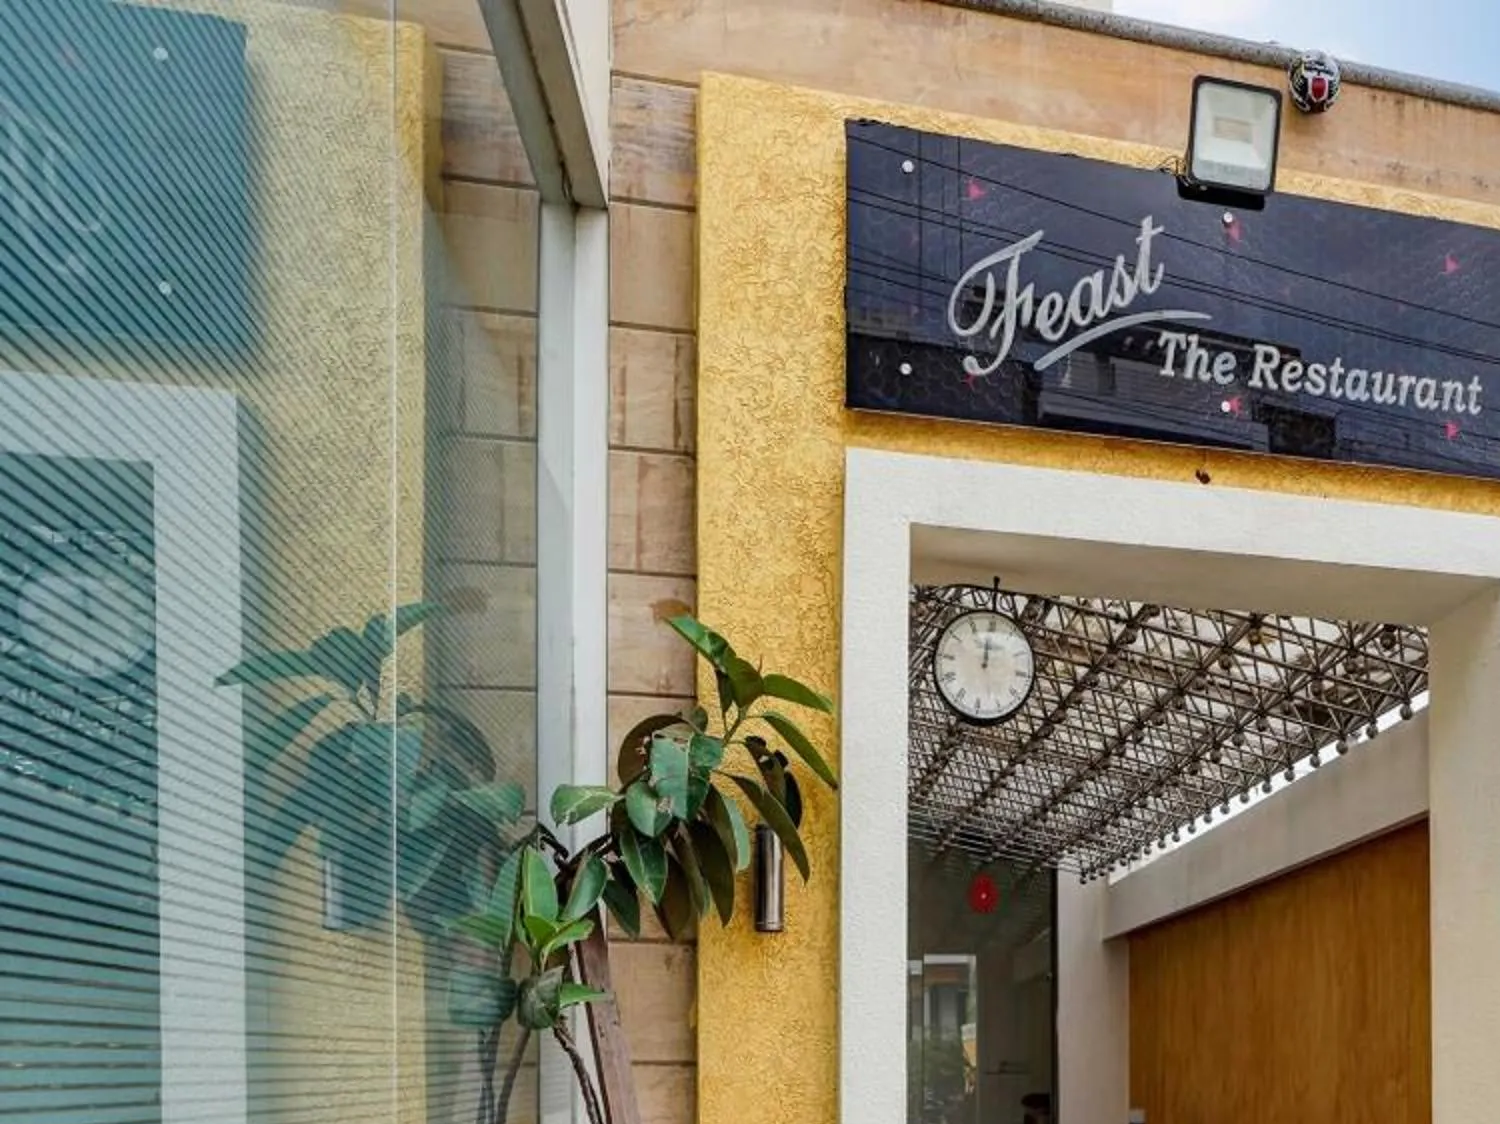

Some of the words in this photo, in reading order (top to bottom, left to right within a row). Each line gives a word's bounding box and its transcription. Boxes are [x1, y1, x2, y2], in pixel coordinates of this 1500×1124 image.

[947, 215, 1165, 377] Feast
[1157, 330, 1236, 384] The
[1247, 343, 1482, 415] Restaurant
